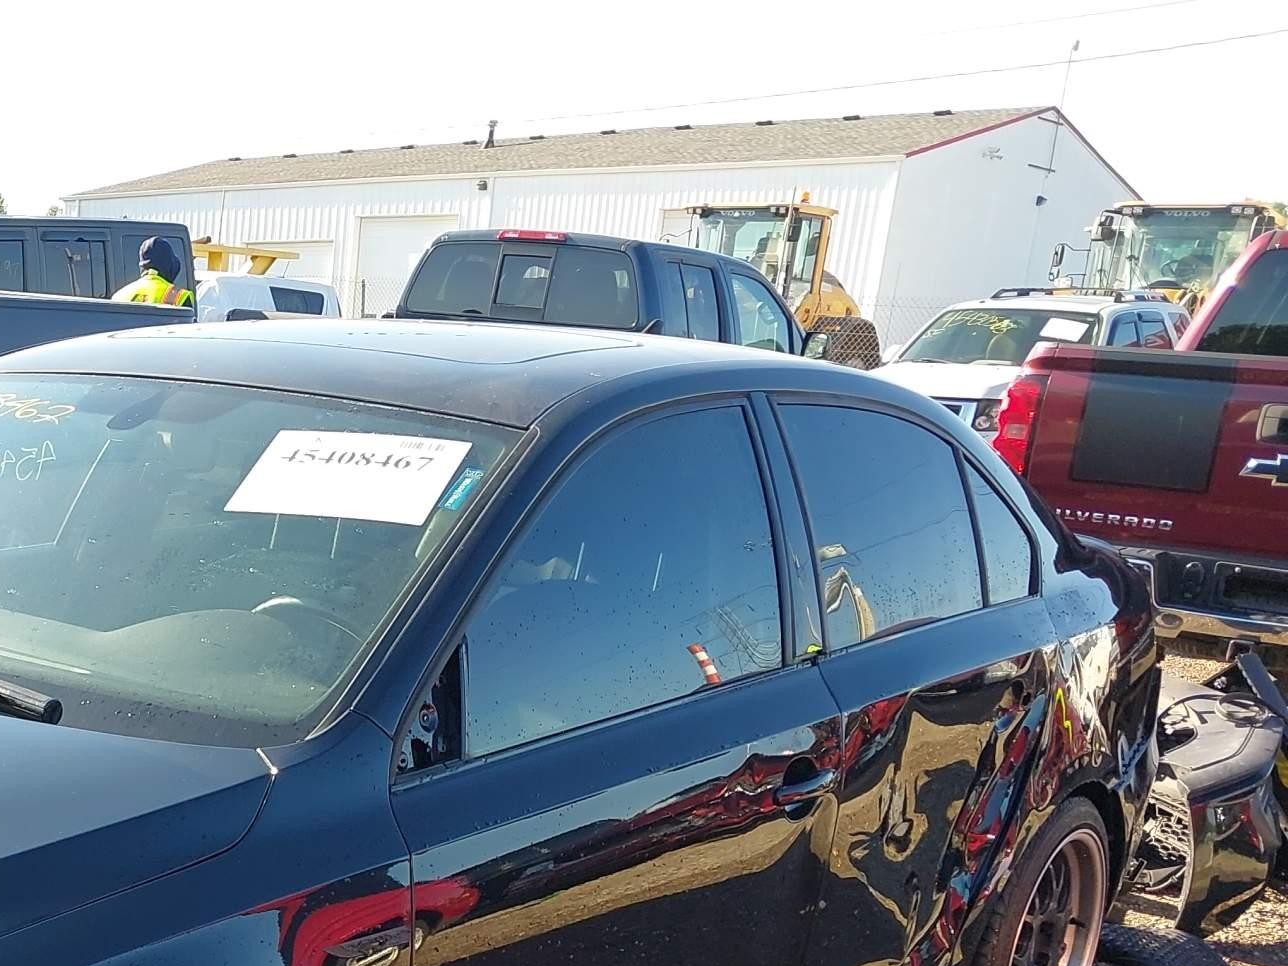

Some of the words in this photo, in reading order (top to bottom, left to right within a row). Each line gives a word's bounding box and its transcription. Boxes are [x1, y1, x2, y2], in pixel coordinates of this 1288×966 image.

[1163, 209, 1211, 217] VOLVO
[280, 448, 435, 472] 45408467
[1055, 508, 1174, 531] ILVERADO
